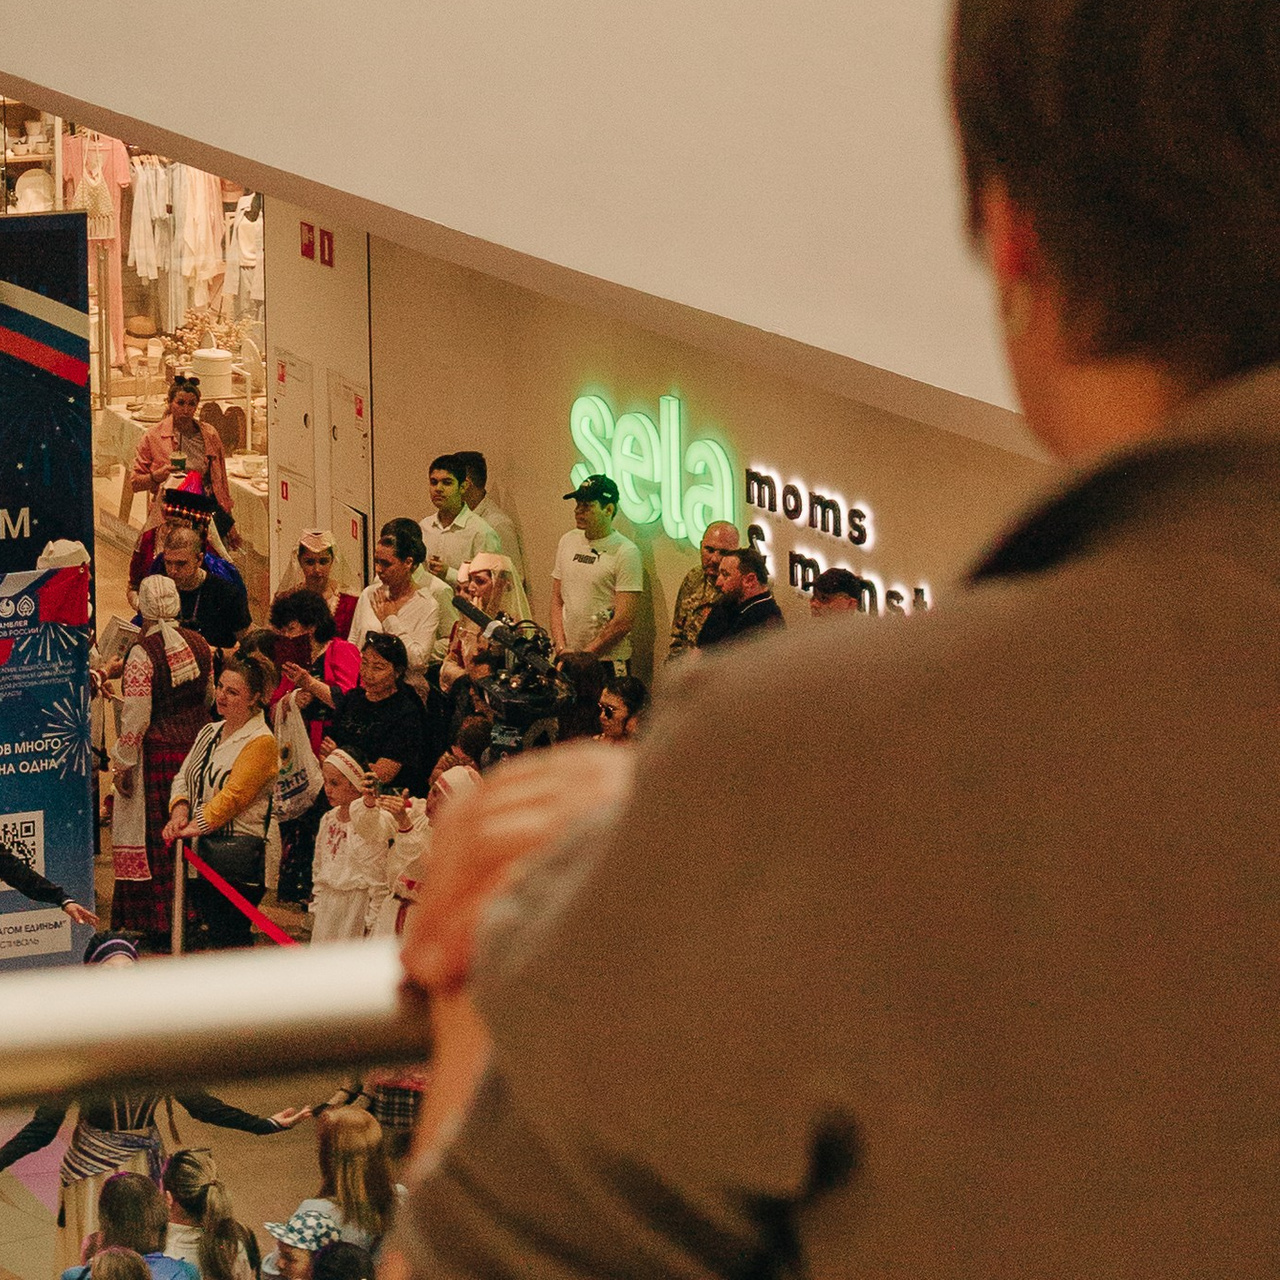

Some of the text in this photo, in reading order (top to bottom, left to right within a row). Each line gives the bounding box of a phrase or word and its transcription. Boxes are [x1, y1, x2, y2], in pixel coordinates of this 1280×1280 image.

[570, 395, 734, 550] sela
[745, 468, 867, 545] moms
[9, 627, 39, 637] РОССИИ
[14, 738, 61, 754] МНОГО
[18, 758, 59, 773] ОДНА
